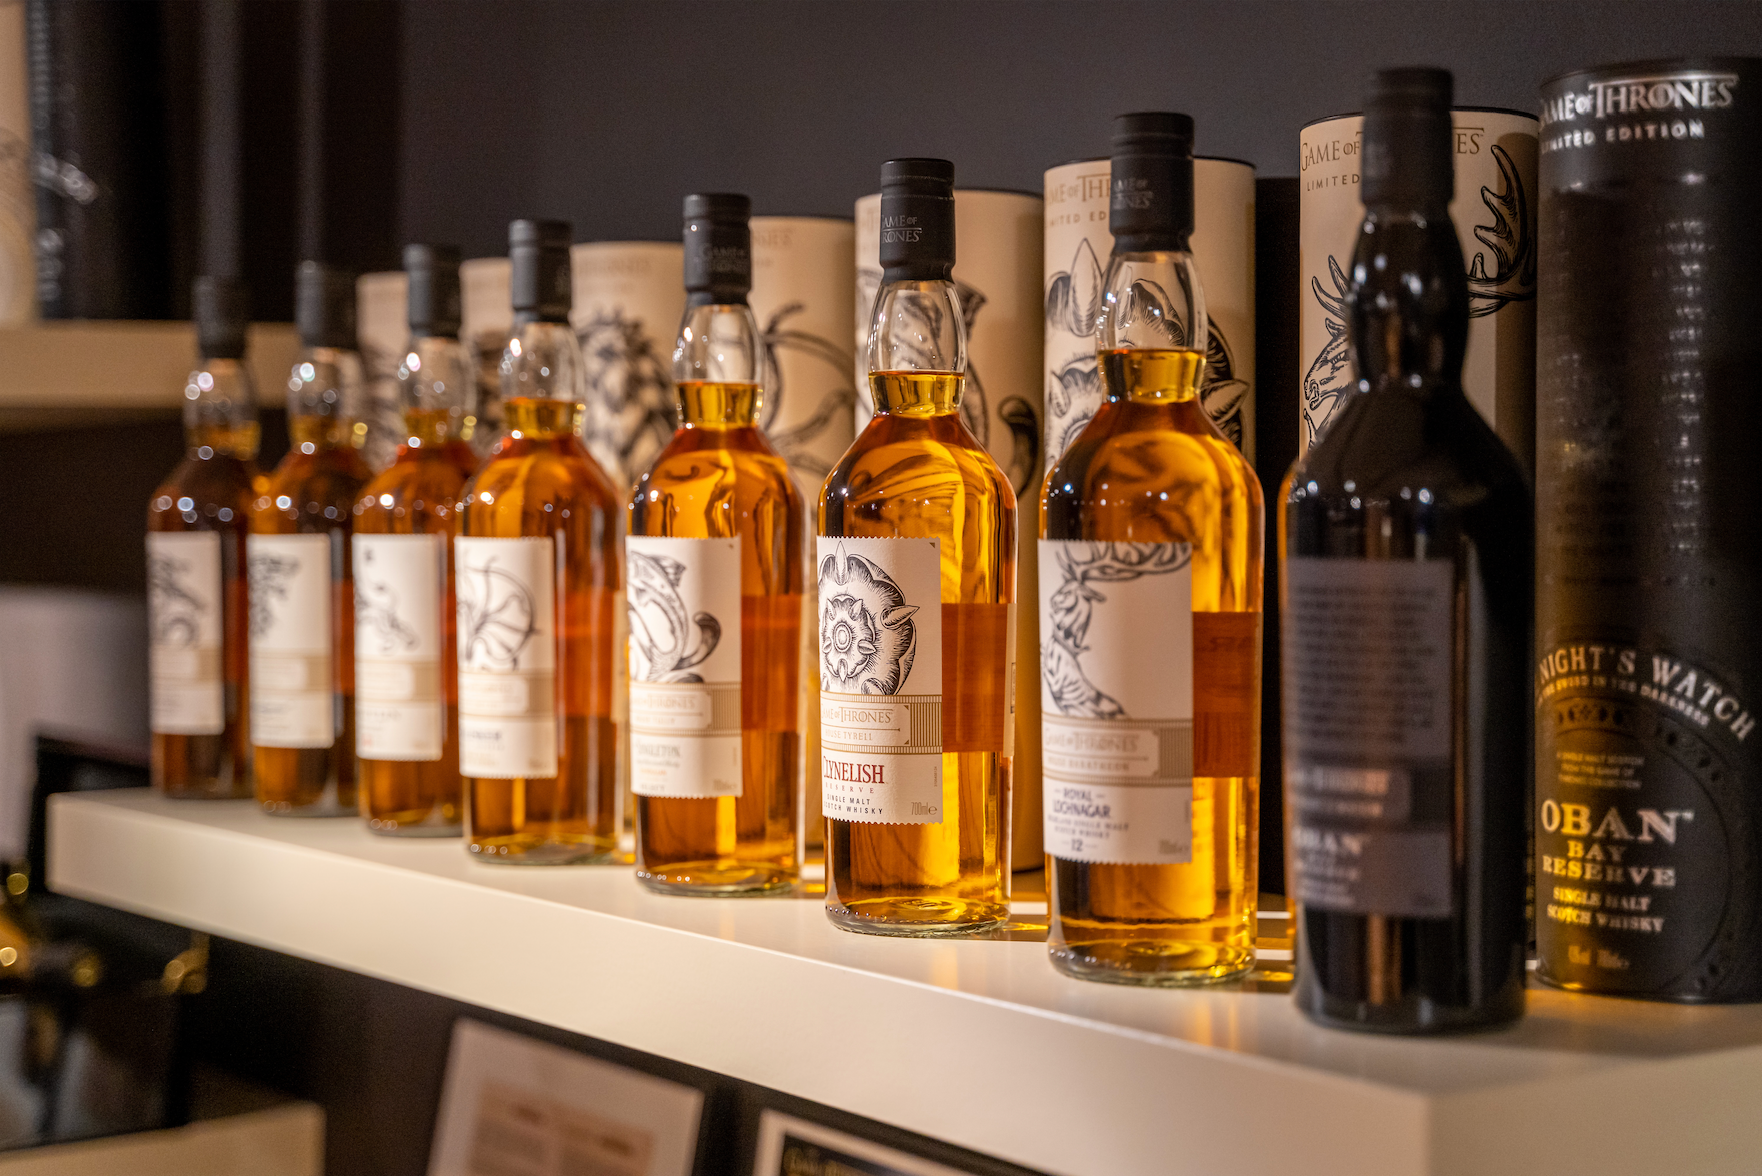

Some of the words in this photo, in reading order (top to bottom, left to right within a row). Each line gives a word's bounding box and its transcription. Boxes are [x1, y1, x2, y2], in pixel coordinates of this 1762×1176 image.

[1540, 91, 1577, 128] AME
[1588, 75, 1738, 118] THRONES
[1606, 119, 1705, 143] EDITION
[1301, 140, 1340, 171] GAME
[1343, 141, 1360, 155] OF
[1307, 174, 1360, 191] LIMITED
[882, 229, 922, 243] RONES
[1652, 656, 1755, 741] WATCH
[839, 707, 894, 723] THRONES
[843, 731, 873, 741] TYRELL
[827, 793, 845, 803] SINGLE
[849, 797, 870, 806] MALT
[1063, 787, 1092, 802] ROYAL
[846, 804, 883, 815] WHISKY
[1541, 799, 1679, 845] OBAN
[1567, 840, 1627, 862] BAY
[1542, 855, 1676, 887] RESERVE
[1553, 886, 1600, 906] SINGLE
[1604, 895, 1651, 911] MALT
[1547, 904, 1591, 925] SCOTCH
[1595, 912, 1665, 932] WHISKY
